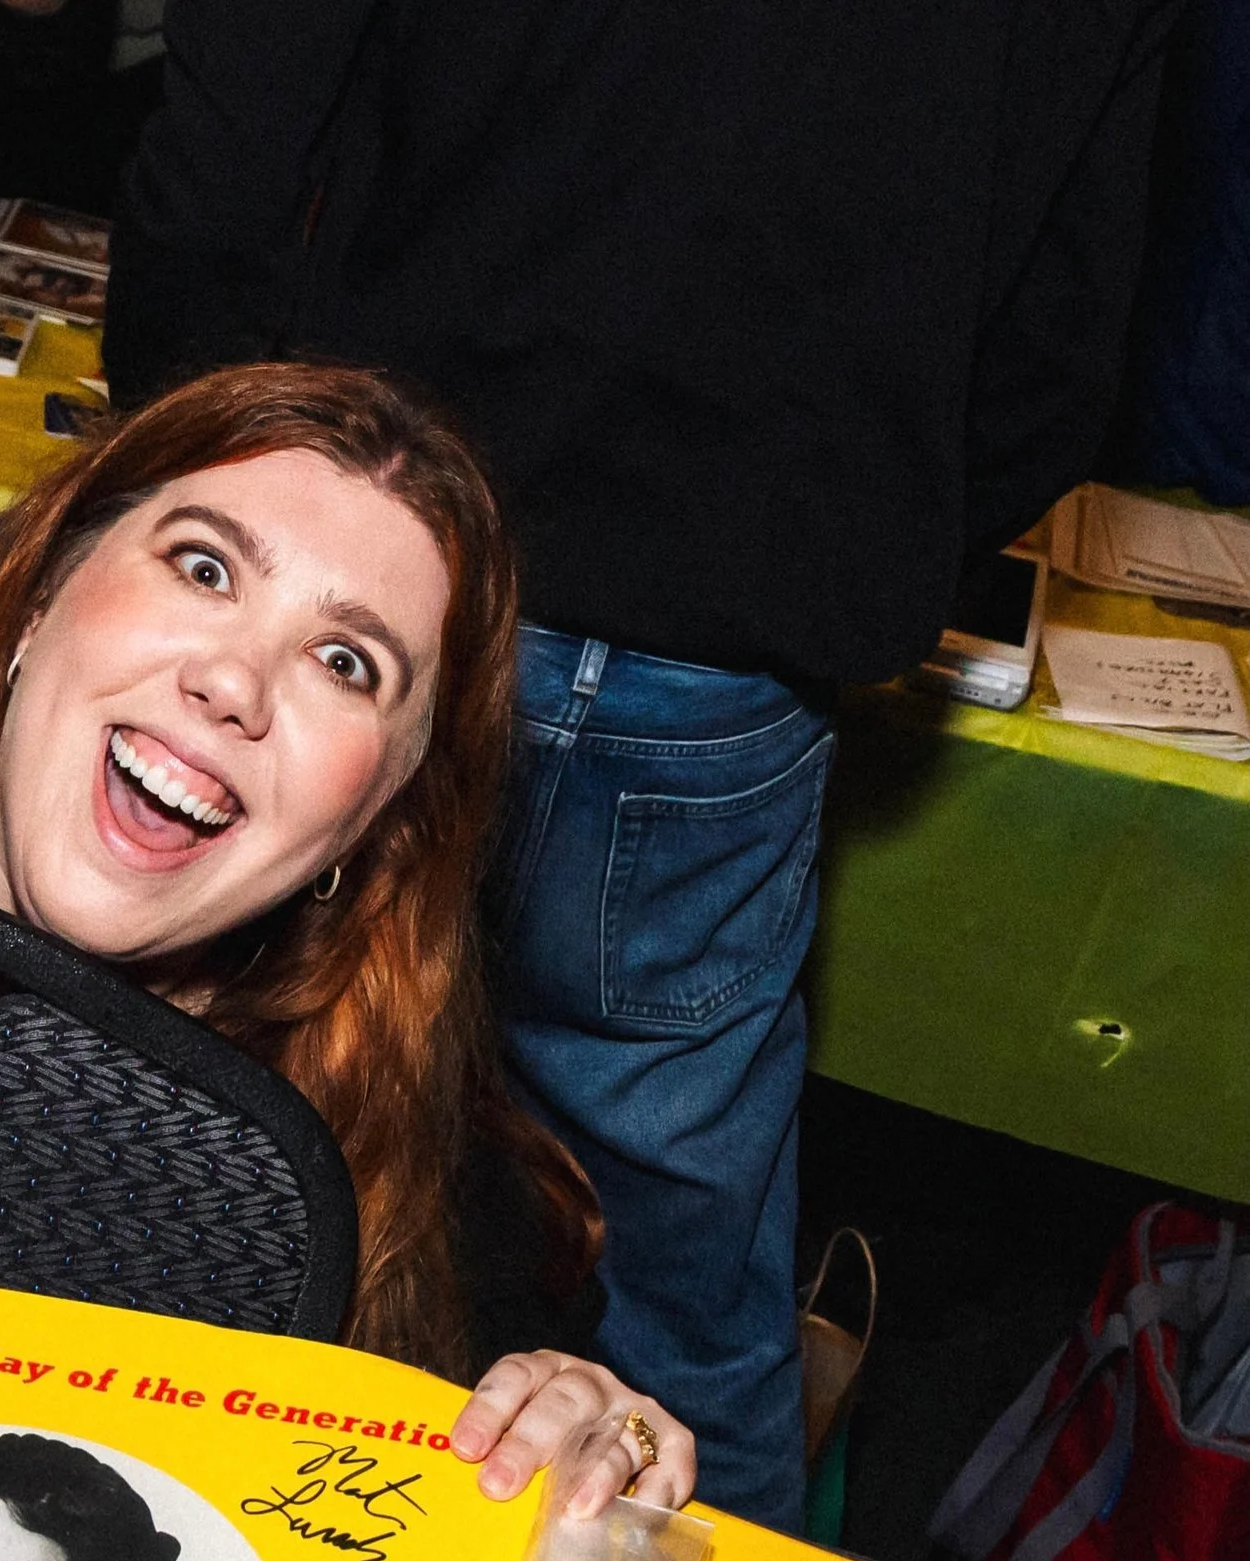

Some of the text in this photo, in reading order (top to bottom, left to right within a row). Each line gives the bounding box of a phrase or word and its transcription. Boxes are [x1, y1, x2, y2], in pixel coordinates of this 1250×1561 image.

[67, 1368, 118, 1393] of
[133, 1376, 206, 1408] the
[222, 1389, 453, 1452] Generatio
